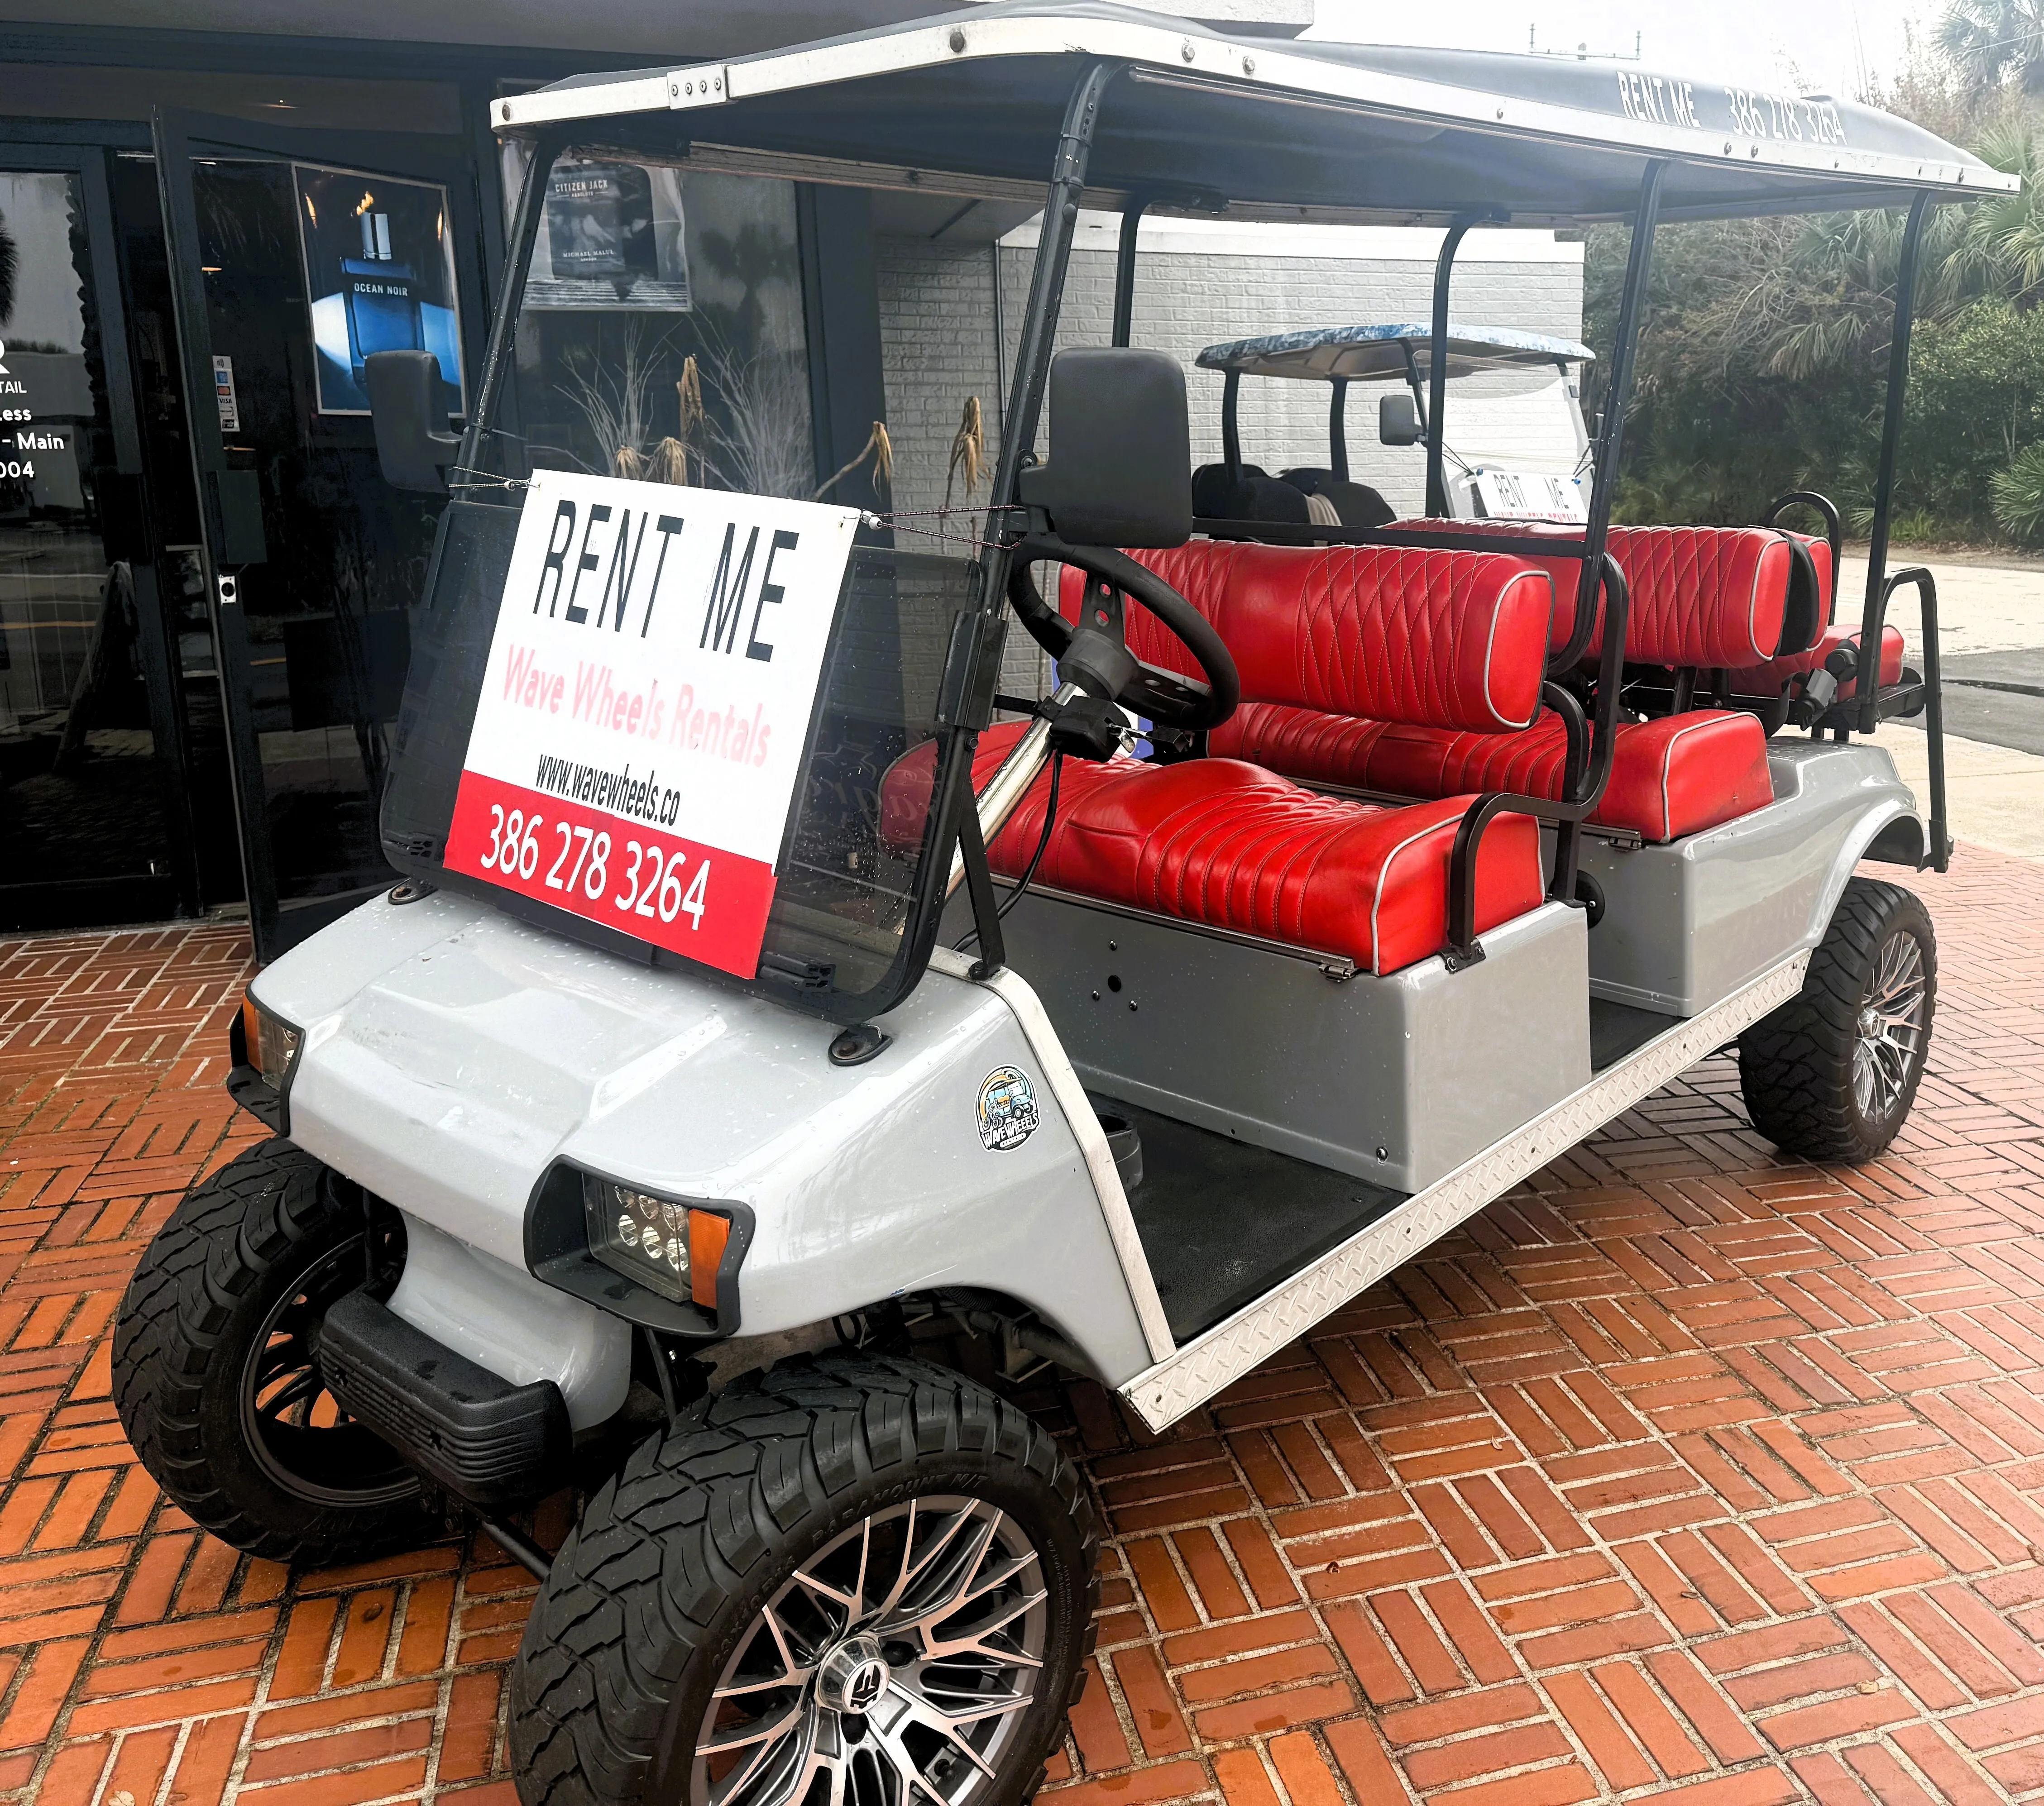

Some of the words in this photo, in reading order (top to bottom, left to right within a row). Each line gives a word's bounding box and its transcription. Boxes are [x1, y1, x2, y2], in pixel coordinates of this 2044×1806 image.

[1617, 71, 1669, 124] RENT
[1668, 80, 1700, 128] ME
[1724, 87, 1766, 138] 386
[1763, 94, 1803, 141] 278
[1801, 100, 1848, 145] 3264
[555, 182, 586, 193] CITIZEN
[589, 179, 608, 190] JACK
[354, 282, 383, 294] OCEAN
[387, 286, 408, 296] NOIR
[17, 432, 64, 450] Main
[1493, 474, 1528, 507] RENT
[1544, 477, 1570, 509] ME
[533, 499, 685, 639] RENT
[699, 522, 800, 662] ME
[503, 643, 565, 714] Wave
[572, 659, 665, 741] Wheels
[669, 684, 772, 768] Rentals
[536, 752, 680, 827] www.wavewheels.co
[480, 803, 543, 881] 386
[546, 821, 613, 901] 278
[614, 839, 712, 931] 3264
